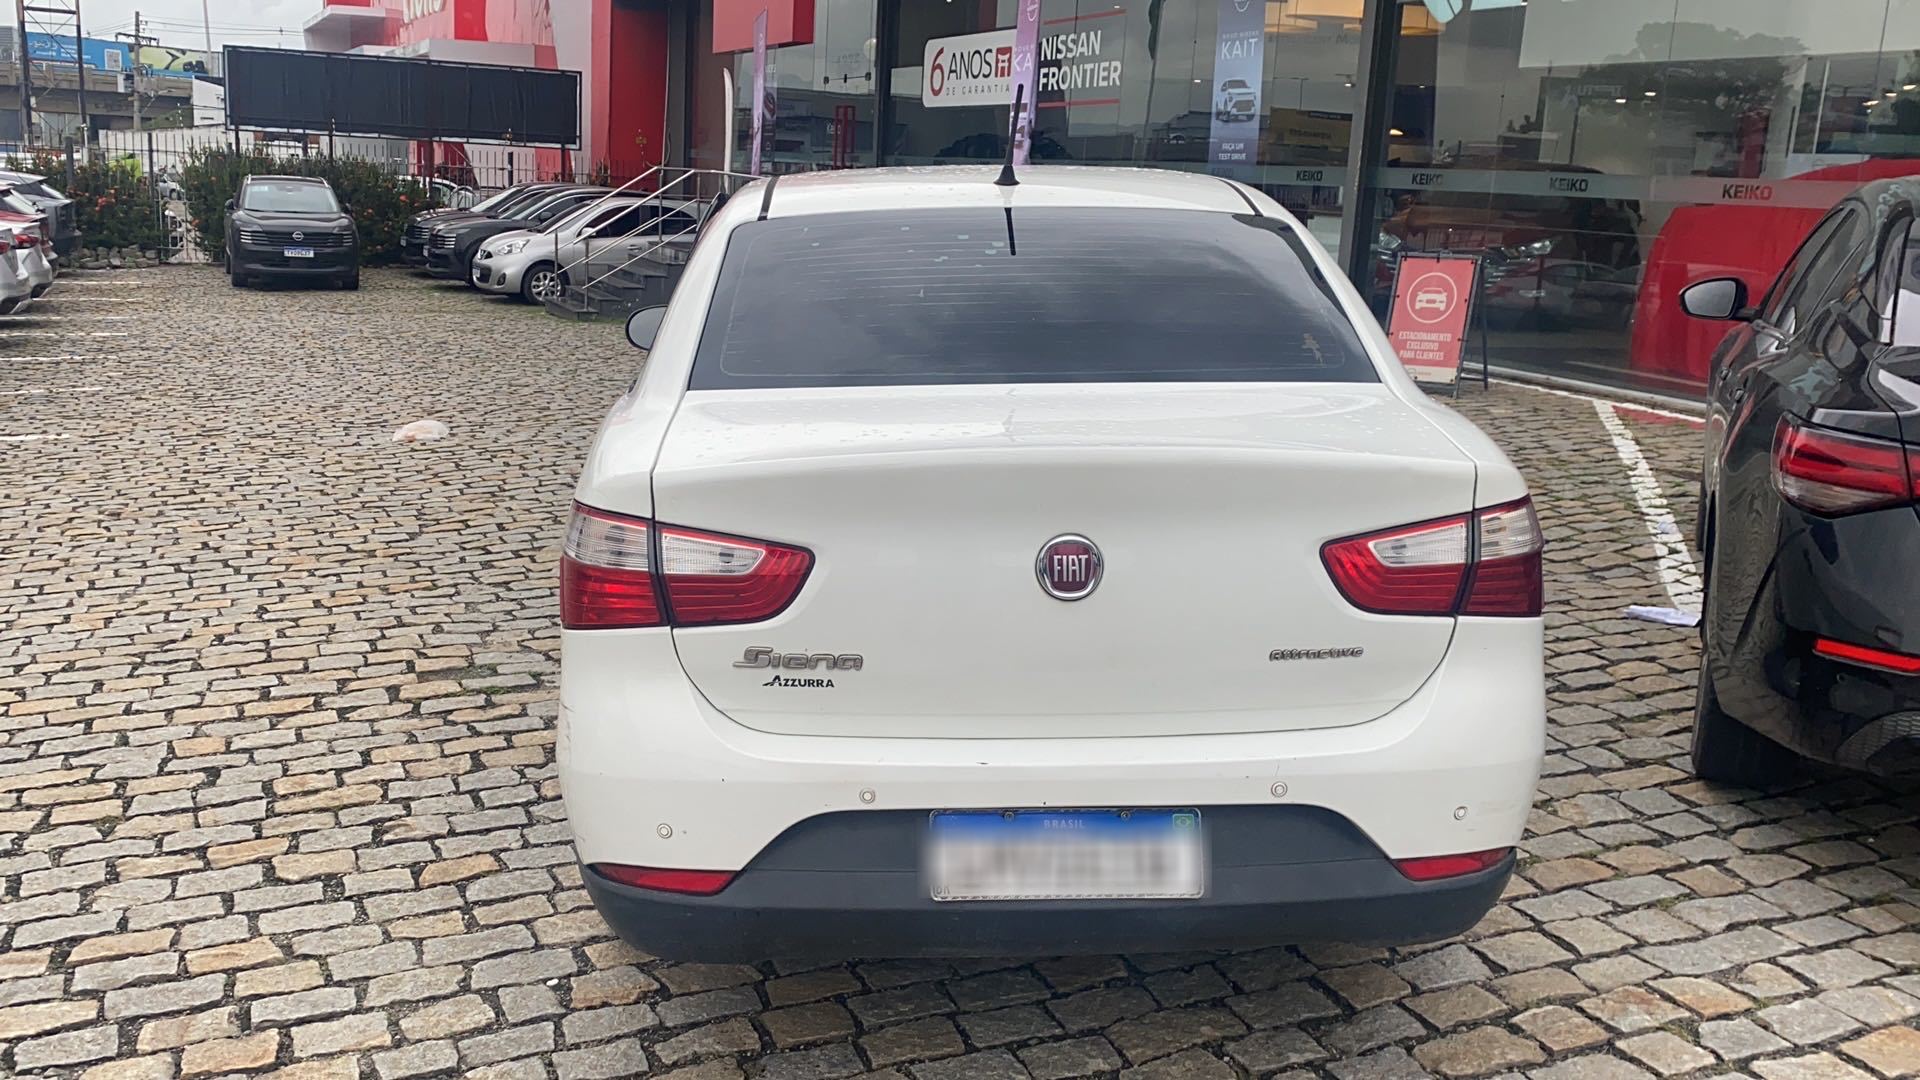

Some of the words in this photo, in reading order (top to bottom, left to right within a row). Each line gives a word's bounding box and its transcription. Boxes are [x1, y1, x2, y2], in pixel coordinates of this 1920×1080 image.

[1041, 30, 1101, 61] NISSAN
[1221, 38, 1258, 60] KAIT
[930, 47, 944, 96] 6
[947, 48, 993, 80] ANOS
[1039, 61, 1121, 91] FRONTIER
[946, 87, 956, 96] DE
[1295, 170, 1323, 182] KEIKO
[1411, 173, 1445, 185] KEIKO
[1549, 177, 1589, 192] KEIKO
[1722, 184, 1772, 200] KEIKO
[1398, 331, 1452, 342] ESTACIONAMENTO
[1406, 340, 1440, 351] EXCLUSIVO
[1399, 350, 1415, 359] PARA
[1415, 350, 1445, 360] CLIENTES
[1053, 554, 1089, 582] FIAT
[732, 646, 864, 671] Siena
[762, 675, 835, 688] AZZURRA
[1043, 819, 1086, 829] BRASIL
